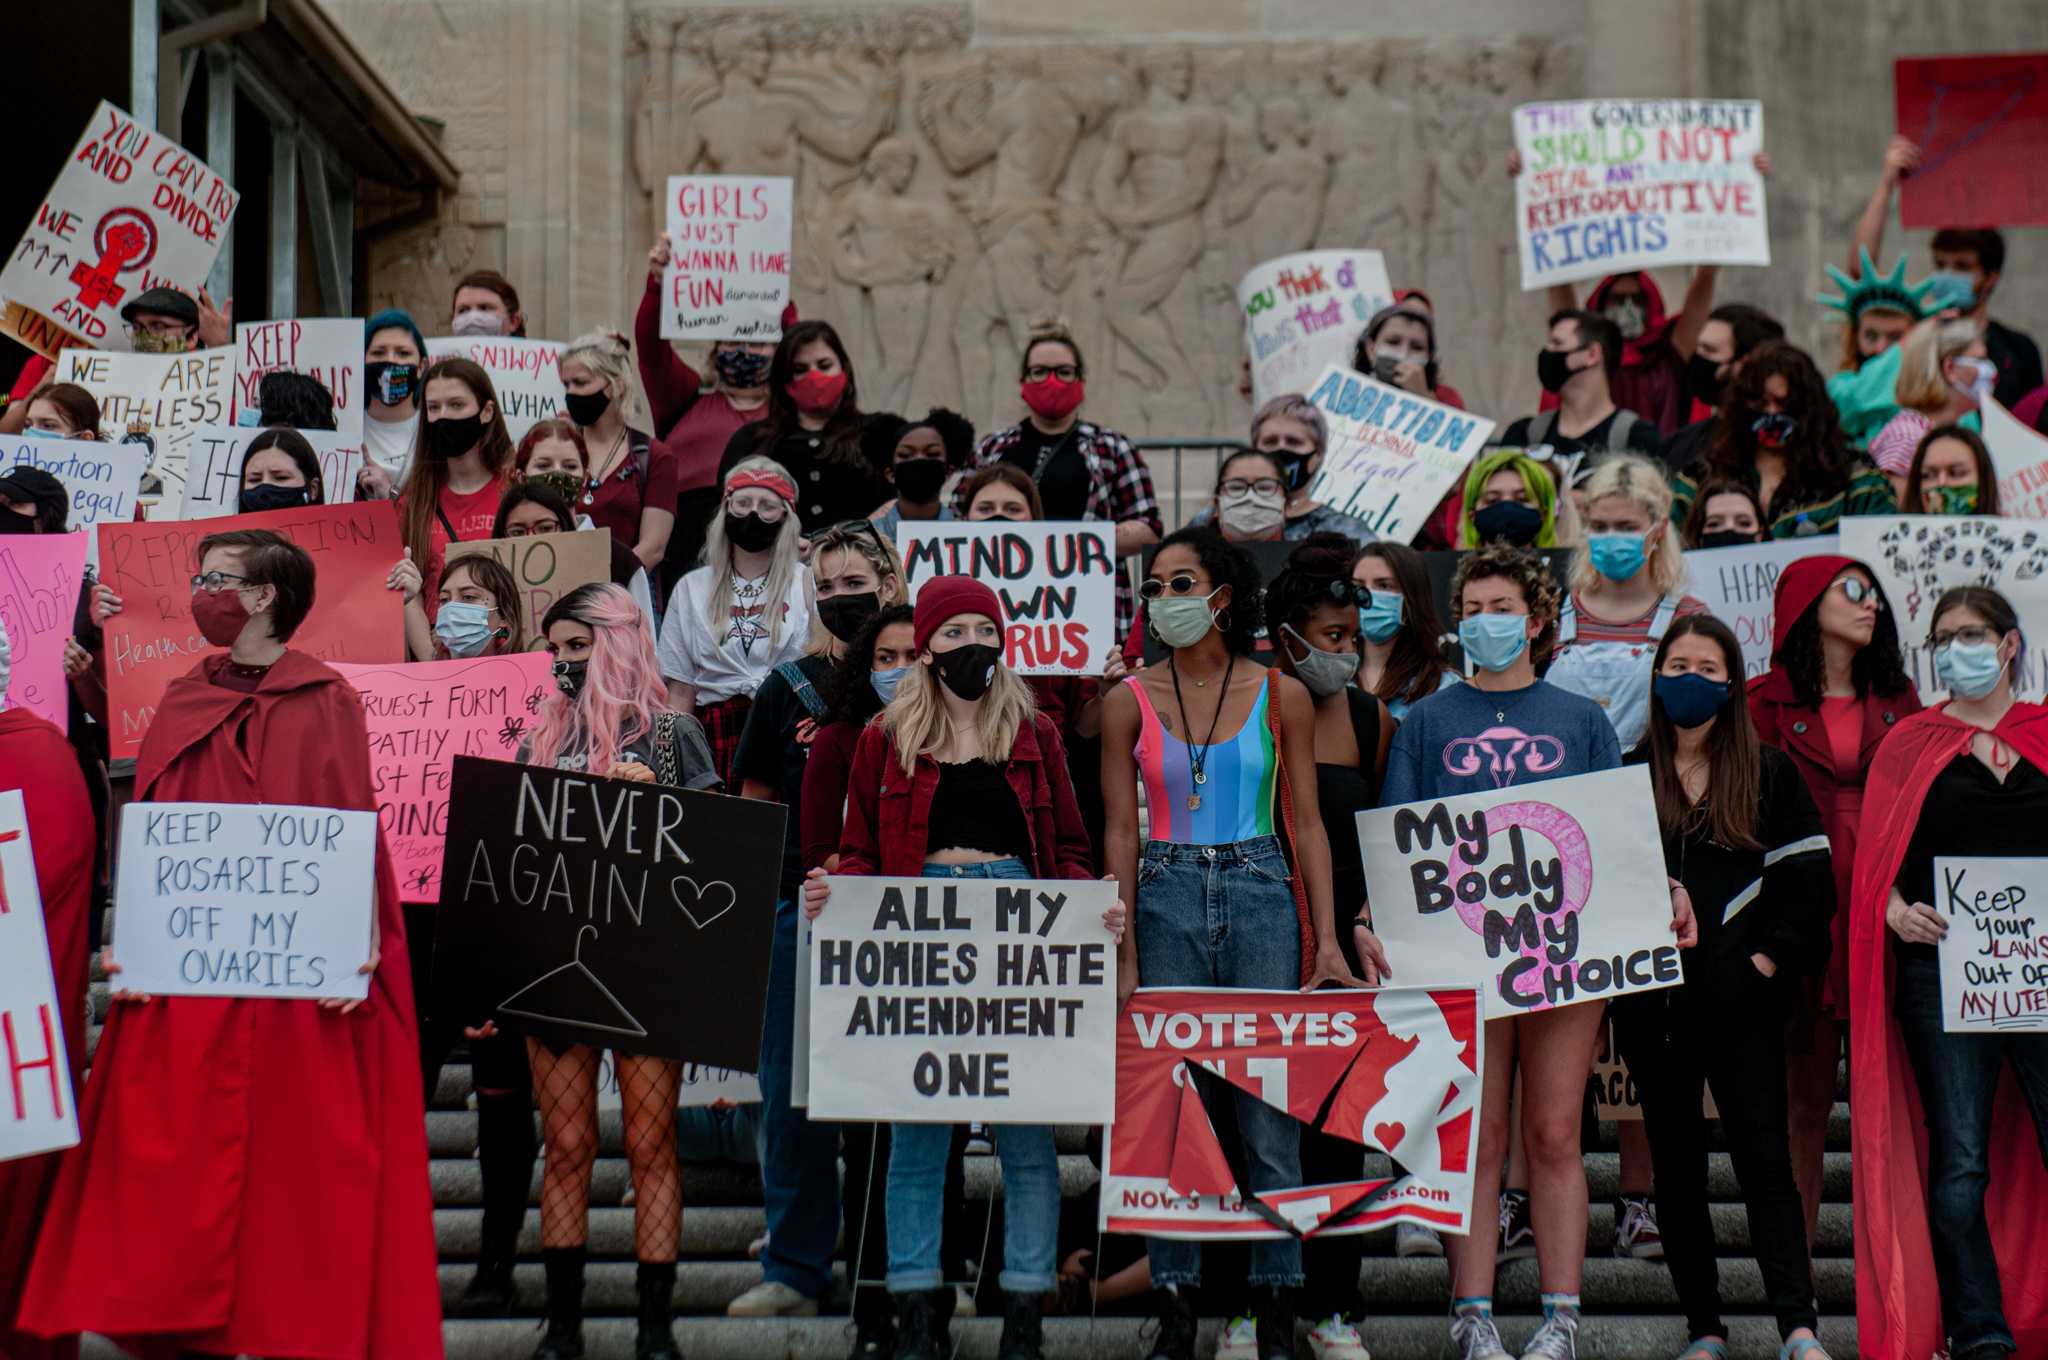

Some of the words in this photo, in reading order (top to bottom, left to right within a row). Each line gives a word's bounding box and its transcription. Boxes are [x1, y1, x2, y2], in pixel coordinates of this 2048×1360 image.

[102, 111, 150, 159] YOU
[152, 149, 205, 193] CAN
[207, 177, 238, 222] TRY
[1530, 128, 1645, 171] SHOULD
[1658, 126, 1740, 163] NOT
[77, 140, 133, 184] AND
[152, 183, 217, 247] DIVIDE
[677, 183, 769, 222] GIRLS
[1527, 180, 1757, 231] REPRODUCTIVE
[37, 203, 83, 243] WE
[680, 222, 739, 245] JUST
[1531, 213, 1668, 272] RIGHTS
[673, 250, 739, 273] WANNA
[750, 251, 791, 275] HAVE
[673, 275, 724, 309] FUN
[52, 298, 107, 339] AND
[246, 320, 302, 368] KEEP
[72, 356, 110, 382] WE
[160, 355, 226, 392] ARE
[97, 393, 222, 427] UTH-LESS
[502, 391, 559, 419] WHAT
[1309, 371, 1477, 453] ABORTION
[13, 445, 113, 483] Abortion
[191, 438, 242, 506] If
[319, 448, 360, 505] OT
[492, 540, 556, 586] NO
[904, 532, 1034, 583] MIND
[1045, 531, 1114, 579] UR
[998, 585, 1077, 622] WN
[1005, 622, 1090, 670] RUS
[447, 684, 508, 719] FORM
[463, 728, 490, 756] IS
[144, 811, 223, 848] KEEP
[258, 811, 345, 852] YOUR
[514, 771, 692, 864] NEVER
[1394, 802, 1489, 866] My
[156, 855, 321, 896] ROSARIES
[464, 839, 649, 927] AGAIN
[1410, 824, 1565, 914] Body
[167, 906, 223, 942] OFF
[250, 910, 299, 950] MY
[873, 886, 972, 931] ALL
[1483, 903, 1579, 965] My
[1975, 916, 2036, 956] your
[181, 949, 328, 988] OVARIES
[819, 940, 978, 987] HOMIES
[996, 943, 1105, 987] HATE
[1964, 961, 2013, 986] Out
[846, 996, 1084, 1038] AMENDMENT
[1960, 990, 1998, 1022] MY
[1131, 1012, 1258, 1049] VOTE
[1271, 1011, 1357, 1047] YES
[913, 1051, 1010, 1098] ONE
[1122, 1189, 1179, 1210] NOV.
